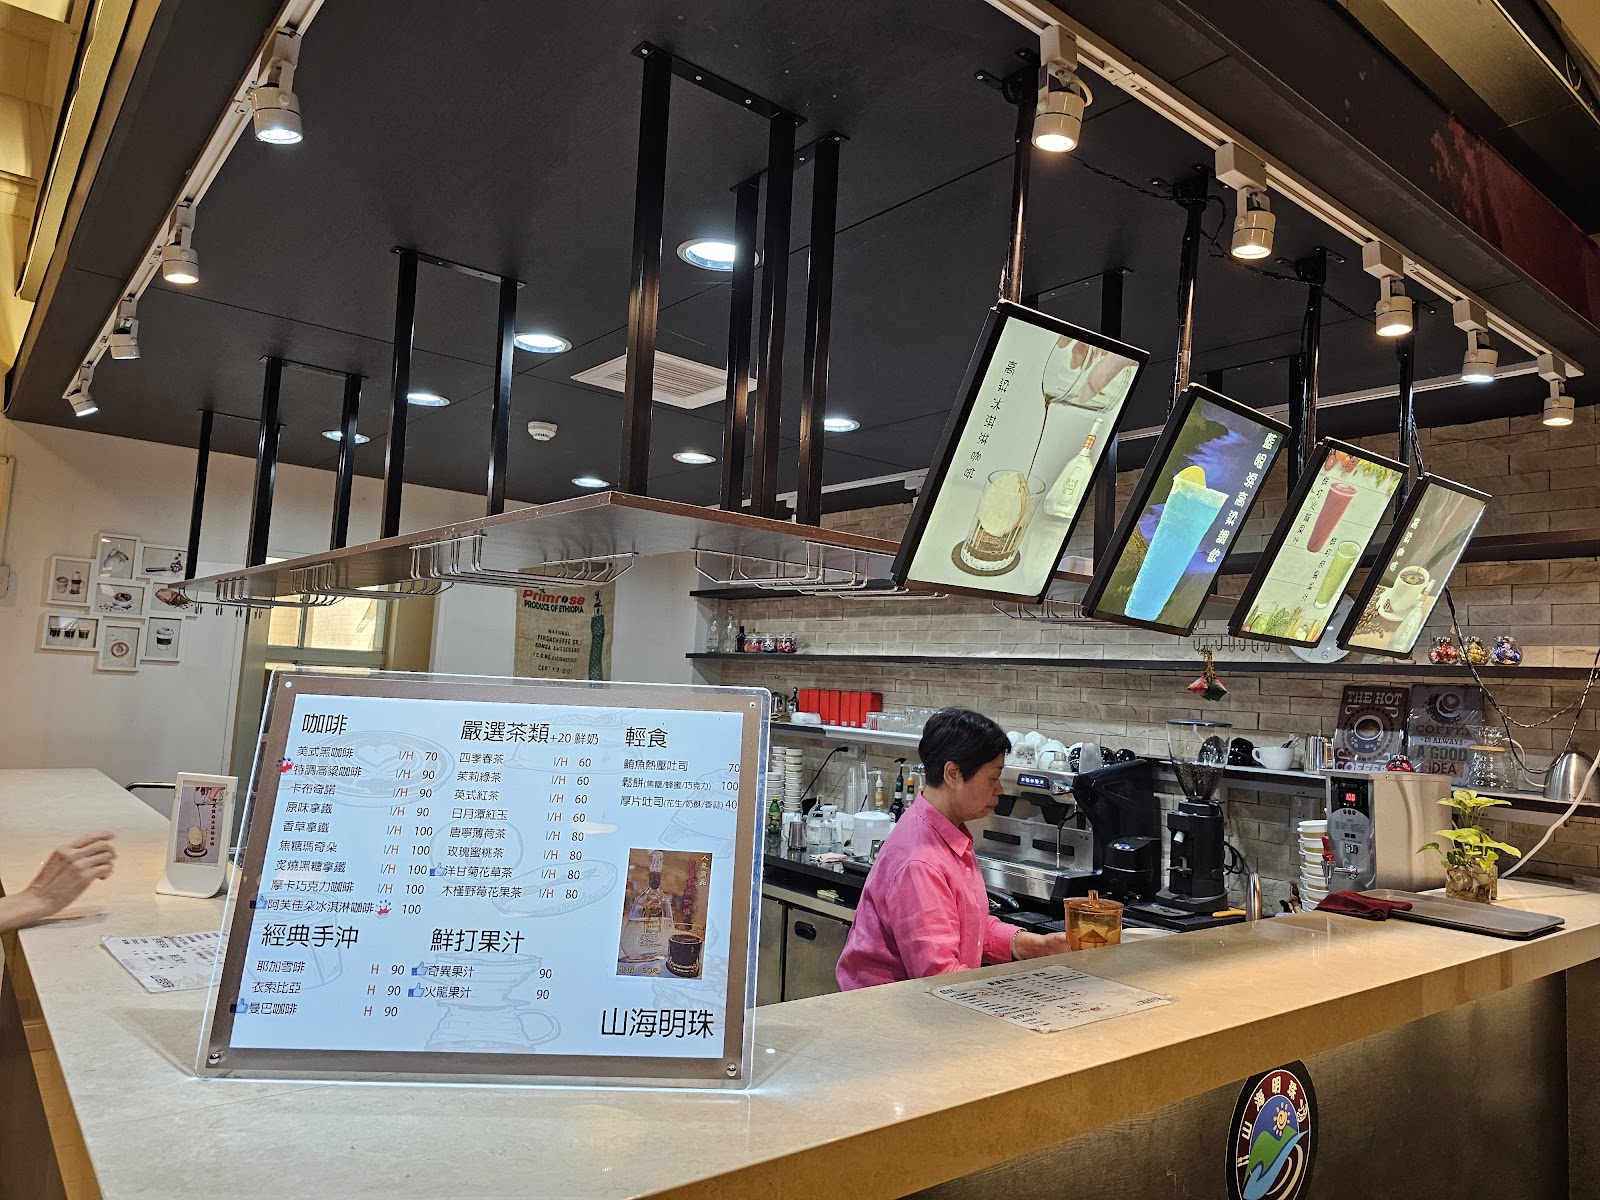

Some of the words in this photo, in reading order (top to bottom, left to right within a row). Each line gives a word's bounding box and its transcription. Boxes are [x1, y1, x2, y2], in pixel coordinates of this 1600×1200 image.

[524, 600, 550, 612] PRODUCE
[559, 604, 584, 613] ETHIOPIA
[1347, 691, 1373, 703] THE
[1376, 692, 1402, 705] HOT
[301, 713, 349, 736] 咖啡
[460, 720, 550, 744] 嚴選茶類
[574, 733, 599, 746] 鮮奶
[625, 726, 669, 749] 輕食
[1431, 737, 1464, 746] ALWAYS
[296, 746, 354, 758] 美式黑咖啡
[398, 750, 414, 761] I/H
[425, 752, 438, 761] 70
[459, 752, 504, 765] 四季春茶
[553, 756, 568, 767] I/H
[578, 757, 592, 768] 60
[1415, 745, 1426, 758] A
[1430, 745, 1468, 761] GOOD
[623, 758, 688, 772] 鮪魚熱壓吐司
[728, 763, 740, 773] 70
[1428, 762, 1457, 775] IDEA
[395, 769, 411, 780] I/H
[422, 770, 435, 780] 90
[456, 770, 502, 784] 茉莉綠茶
[551, 775, 566, 786] I/H
[576, 776, 590, 787] 60
[290, 782, 336, 796] 卡布奇諾
[392, 788, 408, 798] I/H
[419, 788, 432, 799] 90
[721, 781, 739, 791] 100
[454, 789, 500, 802] 英式紅茶
[549, 794, 564, 804] I/H
[574, 794, 588, 805] 60
[725, 800, 738, 810] 40
[285, 801, 333, 815] 原味拿鐵
[389, 806, 405, 817] I/H
[416, 807, 430, 818] 90
[452, 808, 508, 822] 日月潭紅玉
[546, 812, 562, 823] I/H
[572, 813, 586, 824] 60
[282, 820, 330, 834] 香草拿鐵
[386, 826, 402, 836] I/H
[414, 826, 433, 837] 100
[450, 826, 507, 840] 唐寧薄荷茶
[545, 831, 561, 842] I/H
[571, 832, 585, 842] 80
[278, 840, 337, 854] 焦糖瑪奇朵
[383, 844, 399, 856] I/H
[411, 845, 431, 856] 100
[446, 846, 505, 859] 玫瑰蜜桃茶
[543, 850, 559, 861] I/H
[569, 850, 583, 862] 80
[274, 860, 346, 873] 炙燒黑糖拿鐵
[380, 864, 396, 876] I/H
[408, 865, 428, 876] 100
[444, 865, 514, 879] 洋甘菊花草茶
[541, 869, 557, 880] I/H
[567, 870, 581, 881] 80
[271, 880, 354, 893] 摩卡巧克力咖啡
[377, 884, 393, 896] I/H
[405, 885, 425, 896] 100
[442, 884, 523, 899] 木槿野莓花果茶
[538, 889, 555, 900] I/H
[565, 890, 579, 901] 80
[267, 900, 374, 914] 阿芙佳朵冰淇淋咖啡
[402, 904, 422, 915] 100
[260, 923, 360, 949] 經典手沖
[430, 928, 525, 954] 鮮打果汁
[256, 960, 306, 974] 耶加雪啡
[370, 964, 380, 975] H
[391, 965, 405, 976] 90
[428, 966, 475, 978] 奇異果汁
[538, 969, 552, 979] 90
[252, 981, 302, 994] 衣索比亞
[366, 984, 377, 996] H
[387, 986, 402, 997] 90
[424, 986, 472, 999] 火龍果汁
[536, 989, 550, 1000] 90
[248, 1002, 298, 1016] 曼巴咖啡
[363, 1006, 374, 1018] H
[384, 1006, 398, 1018] 90
[601, 1007, 714, 1039] 山海明珠
[1242, 1076, 1298, 1140] 山海明珠
